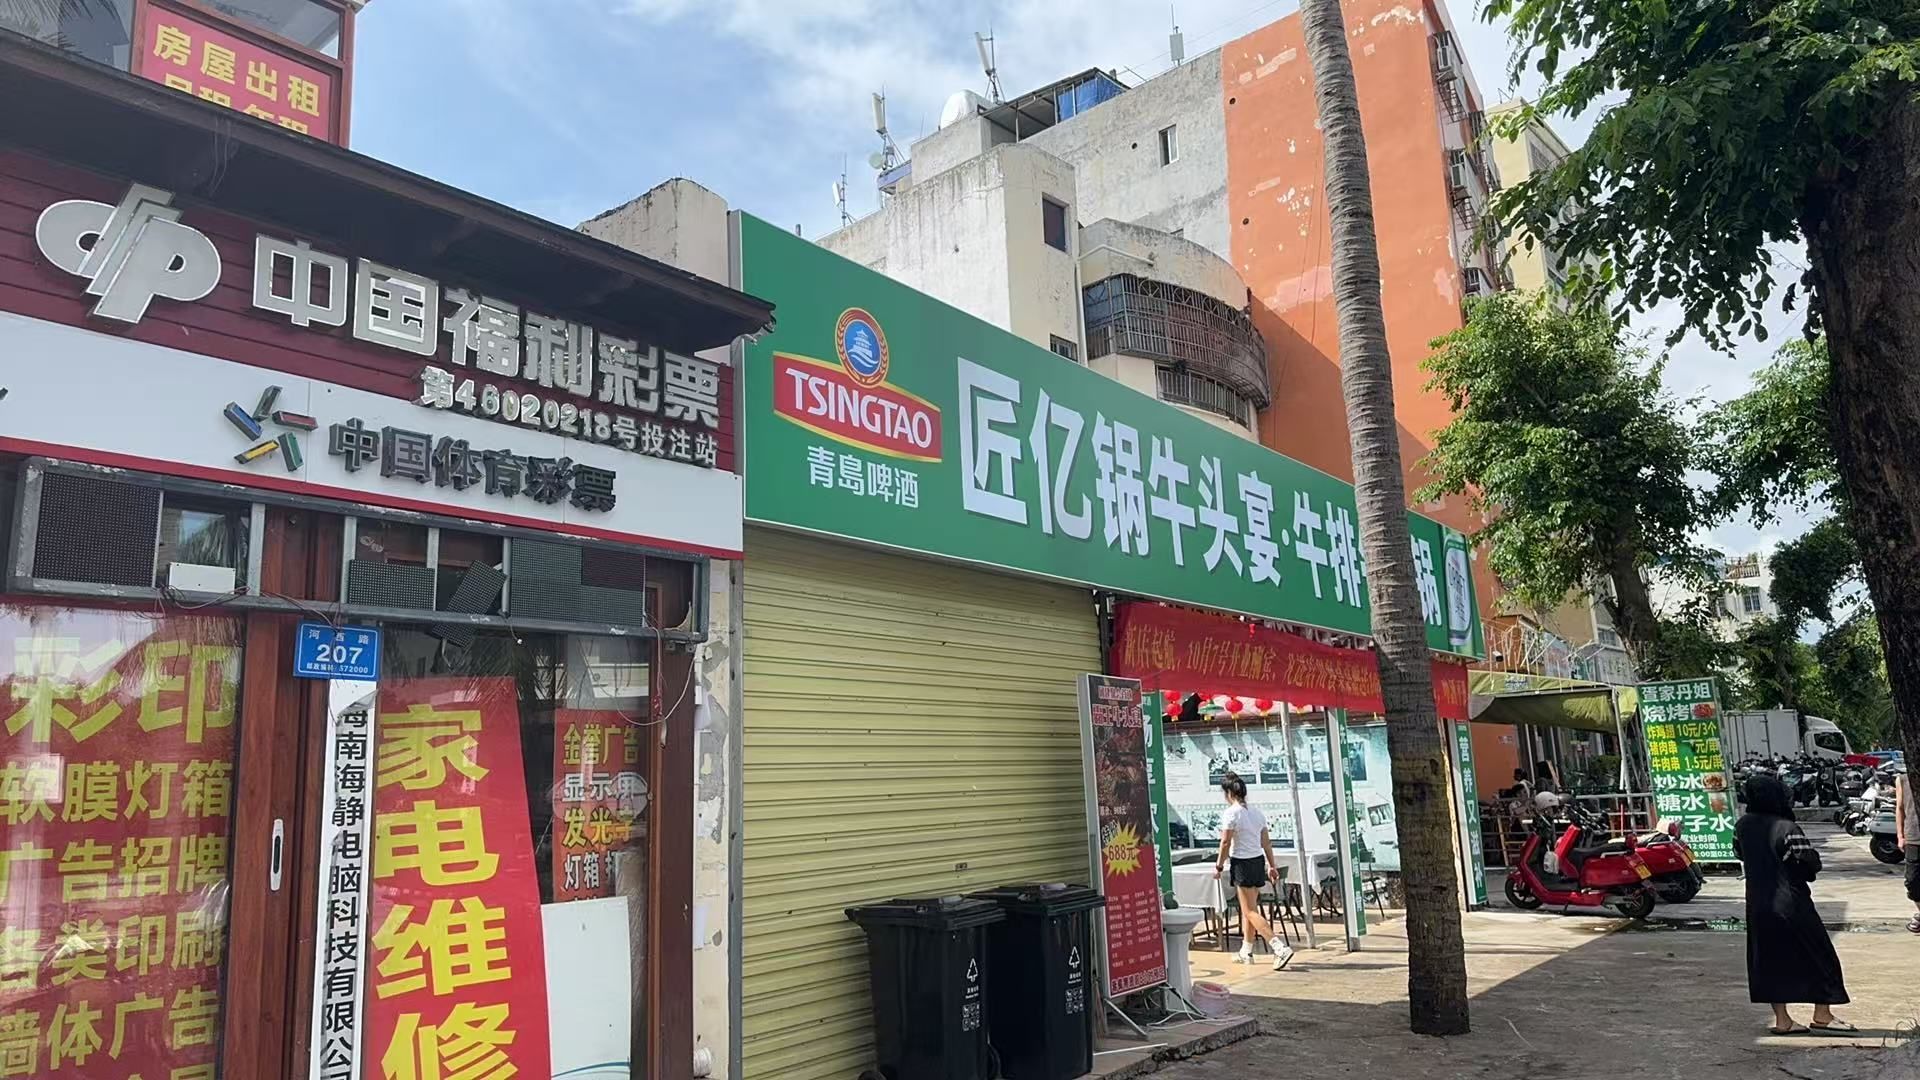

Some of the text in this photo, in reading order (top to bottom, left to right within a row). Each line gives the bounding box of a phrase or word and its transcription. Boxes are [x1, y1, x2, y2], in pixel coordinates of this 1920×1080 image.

[153, 24, 320, 117] 房屋出租
[253, 233, 721, 429] 中国福利彩票
[420, 366, 718, 466] 第46020218号投注站
[786, 368, 932, 448] TSINGTAO
[328, 417, 617, 512] 中国体育彩票
[957, 356, 1442, 627] 匠亿锅牛头宴·牛排锅
[309, 629, 369, 645] 河西路
[316, 644, 363, 664] 207
[5, 637, 242, 743] 彩印
[1643, 703, 1690, 722] 烧烤
[563, 723, 640, 765] 金誉广告
[1648, 738, 1720, 756] 猪肉串 元/串
[1677, 721, 1717, 737] 10元/3个
[562, 770, 635, 802] 显示屏
[1652, 757, 1681, 771] 牛肉串
[1654, 773, 1704, 792] 炒冰
[0, 758, 233, 826] 软膜灯箱
[1656, 793, 1706, 811] 糖水
[562, 805, 635, 847] 发光字
[1109, 842, 1136, 861] 688元
[0, 836, 229, 903] 广告招牌
[372, 704, 519, 1080] 家电维修
[0, 912, 226, 989] 各类印刷
[0, 985, 219, 1077] 墙体广告
